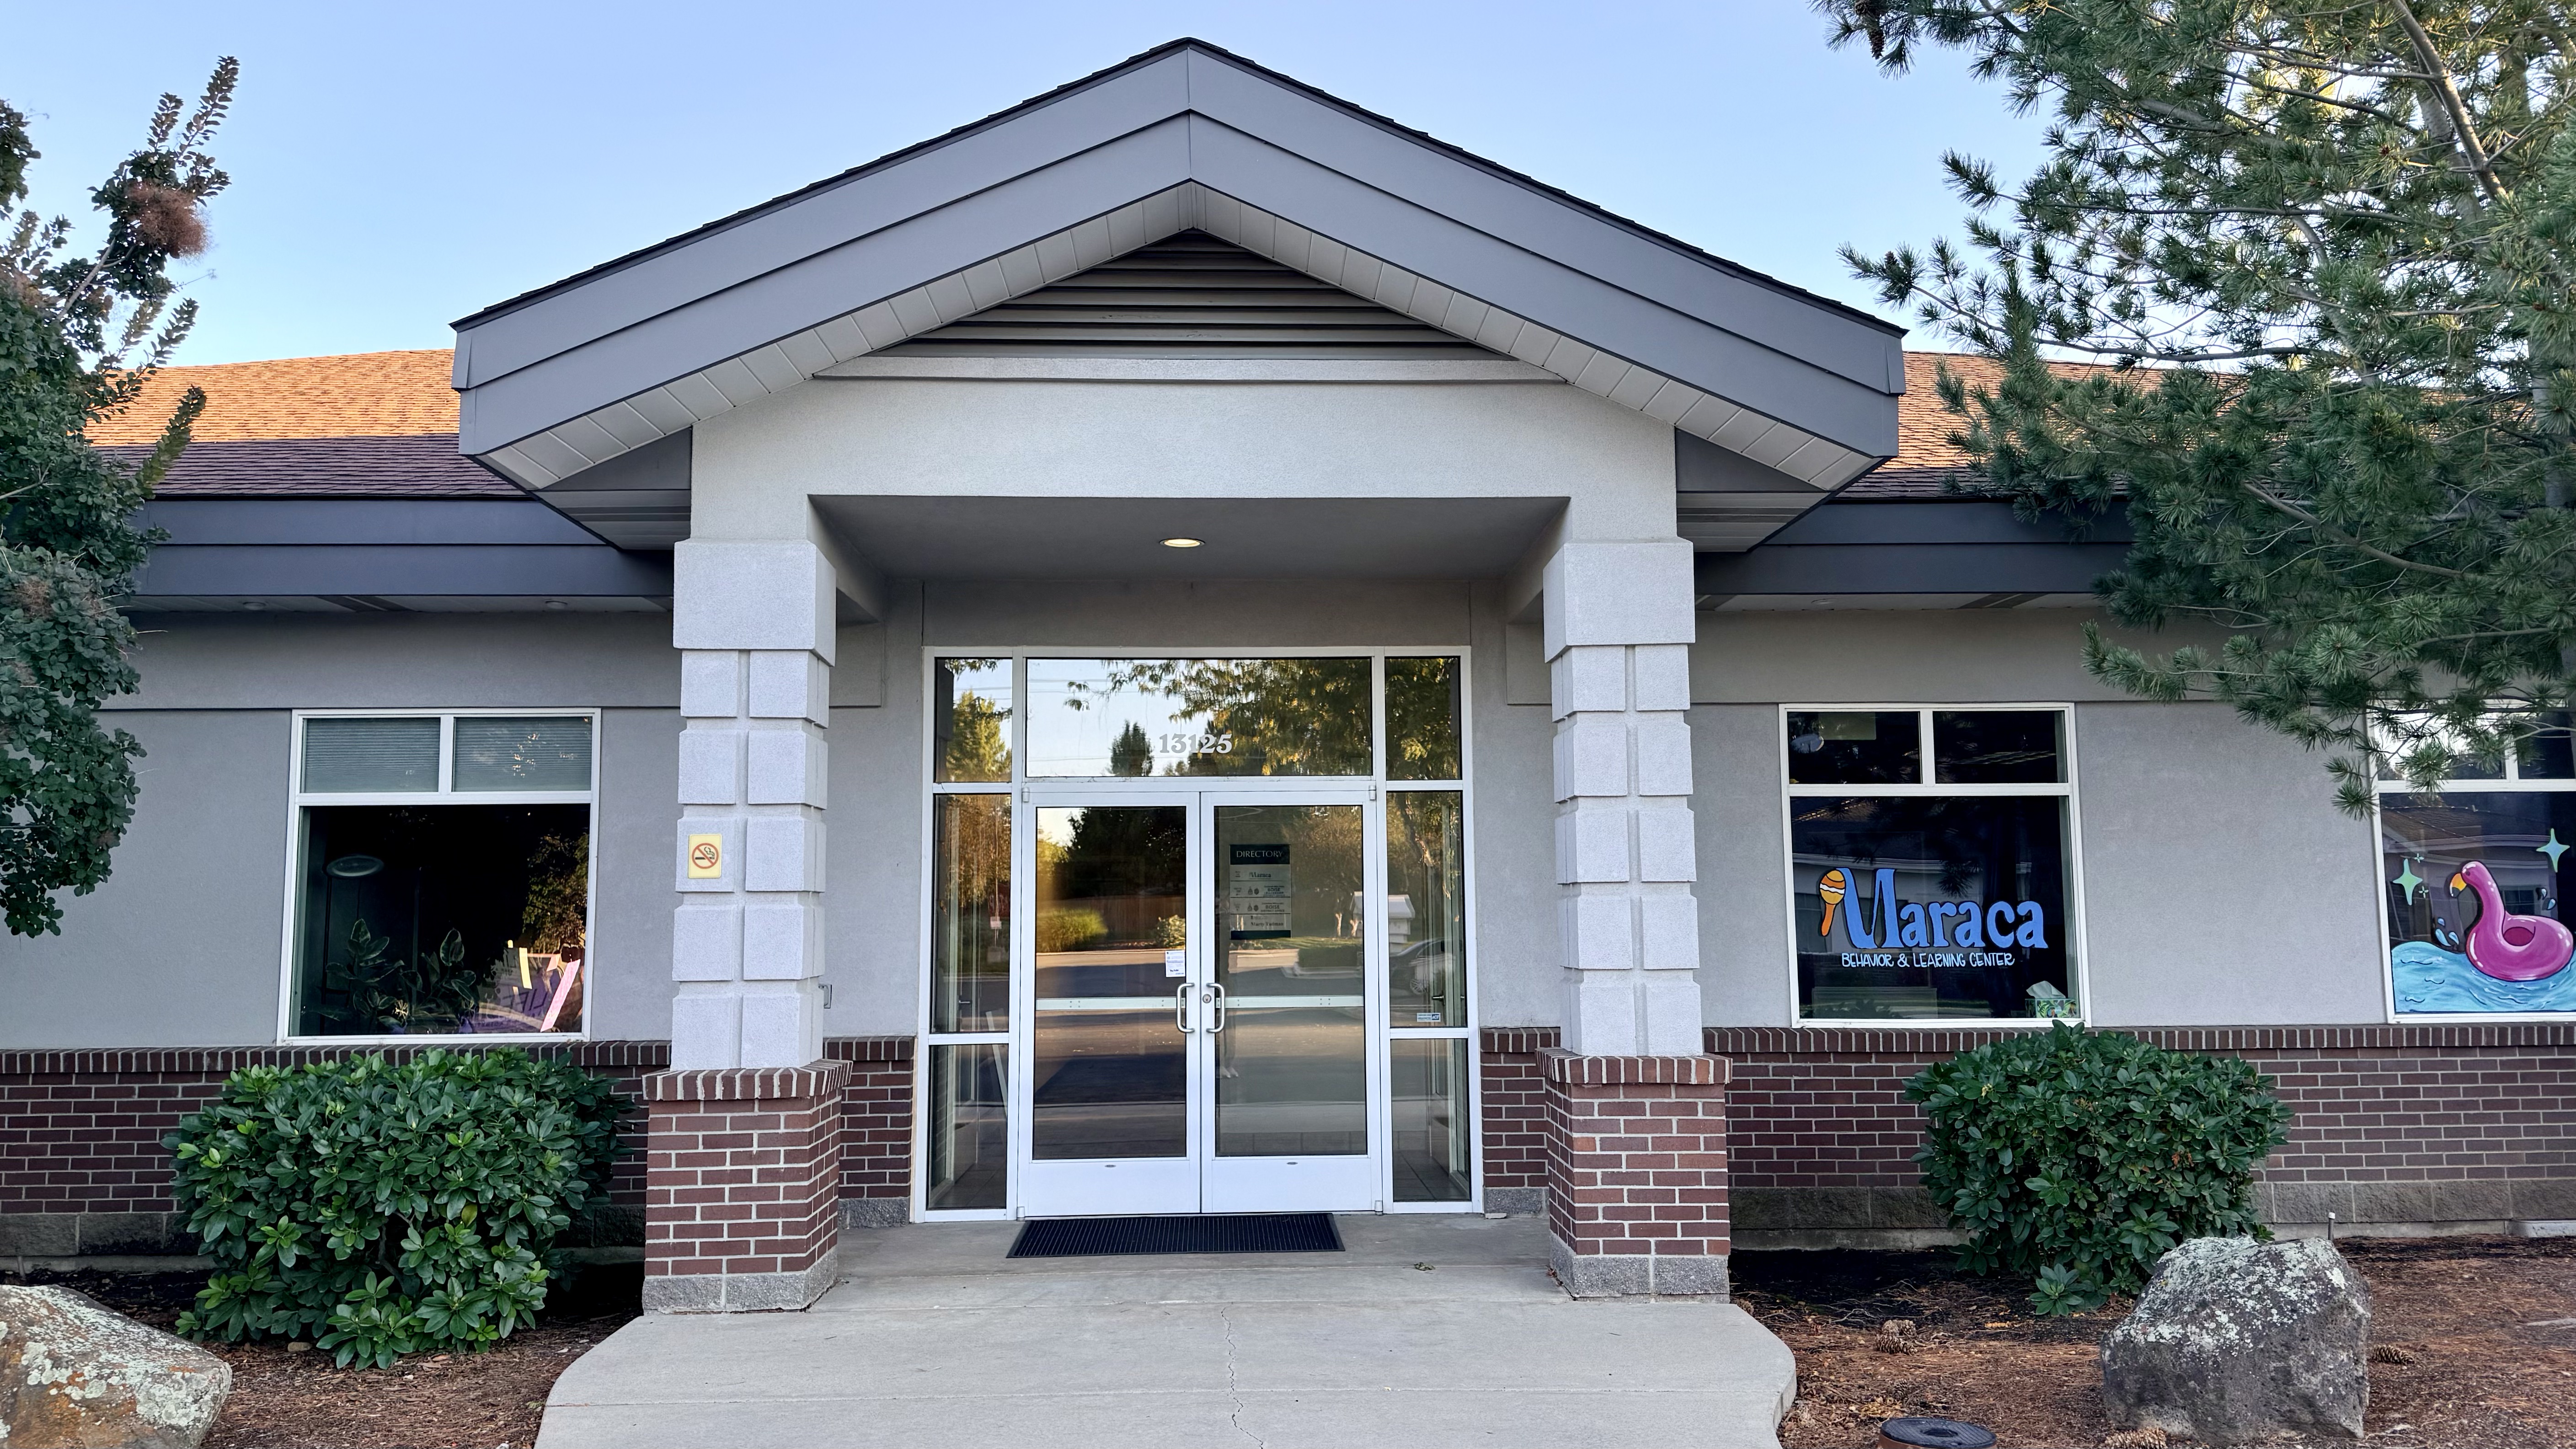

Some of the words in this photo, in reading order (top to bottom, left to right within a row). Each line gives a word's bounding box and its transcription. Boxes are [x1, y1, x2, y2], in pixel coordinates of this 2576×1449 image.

[1159, 733, 1232, 754] 13125
[1819, 867, 2049, 949] Maraca
[1842, 952, 1894, 967] BEHAVIOR
[1897, 953, 1910, 967] &
[1913, 953, 1966, 968] LEARNING
[1969, 952, 2015, 967] CENTER
